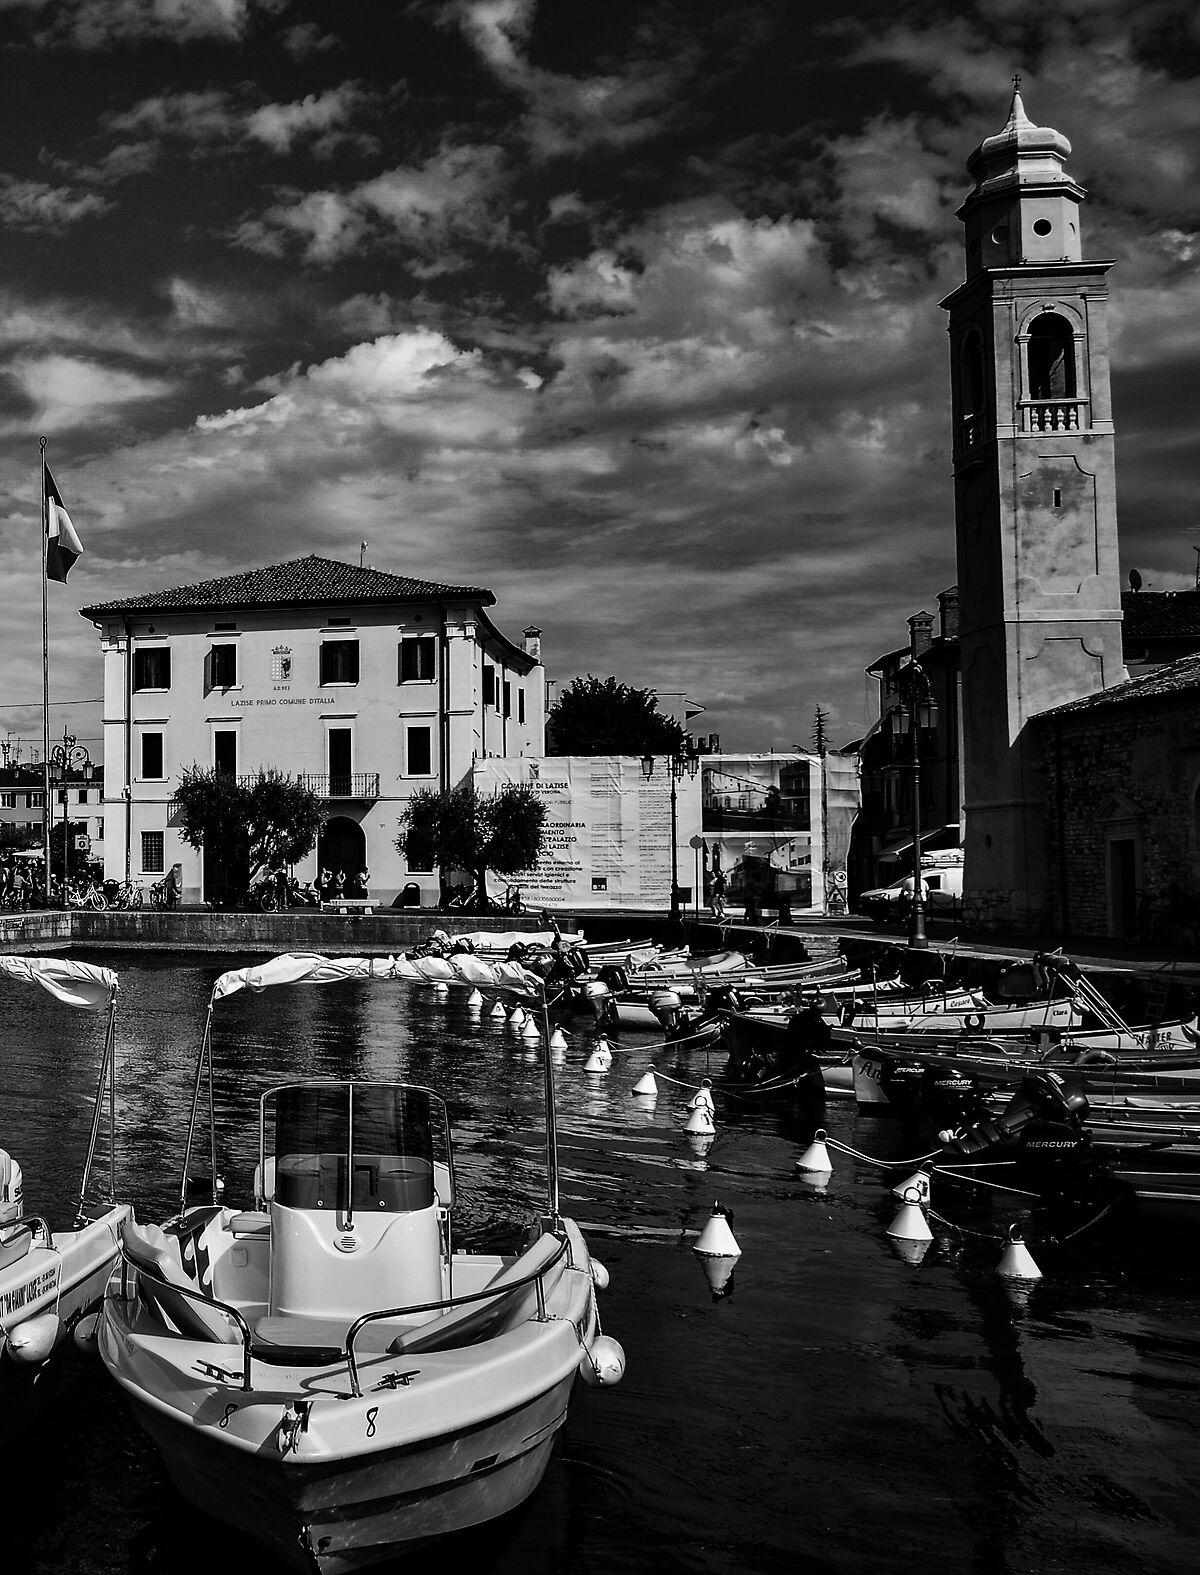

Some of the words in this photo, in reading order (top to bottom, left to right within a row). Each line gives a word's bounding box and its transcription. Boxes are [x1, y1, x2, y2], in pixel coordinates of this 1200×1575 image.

[1052, 1009, 1068, 1017] Clara
[933, 1079, 973, 1087] MERCURY
[1026, 1141, 1078, 1149] MERCURY
[219, 1402, 238, 1428] 8
[366, 1407, 378, 1437] 8
